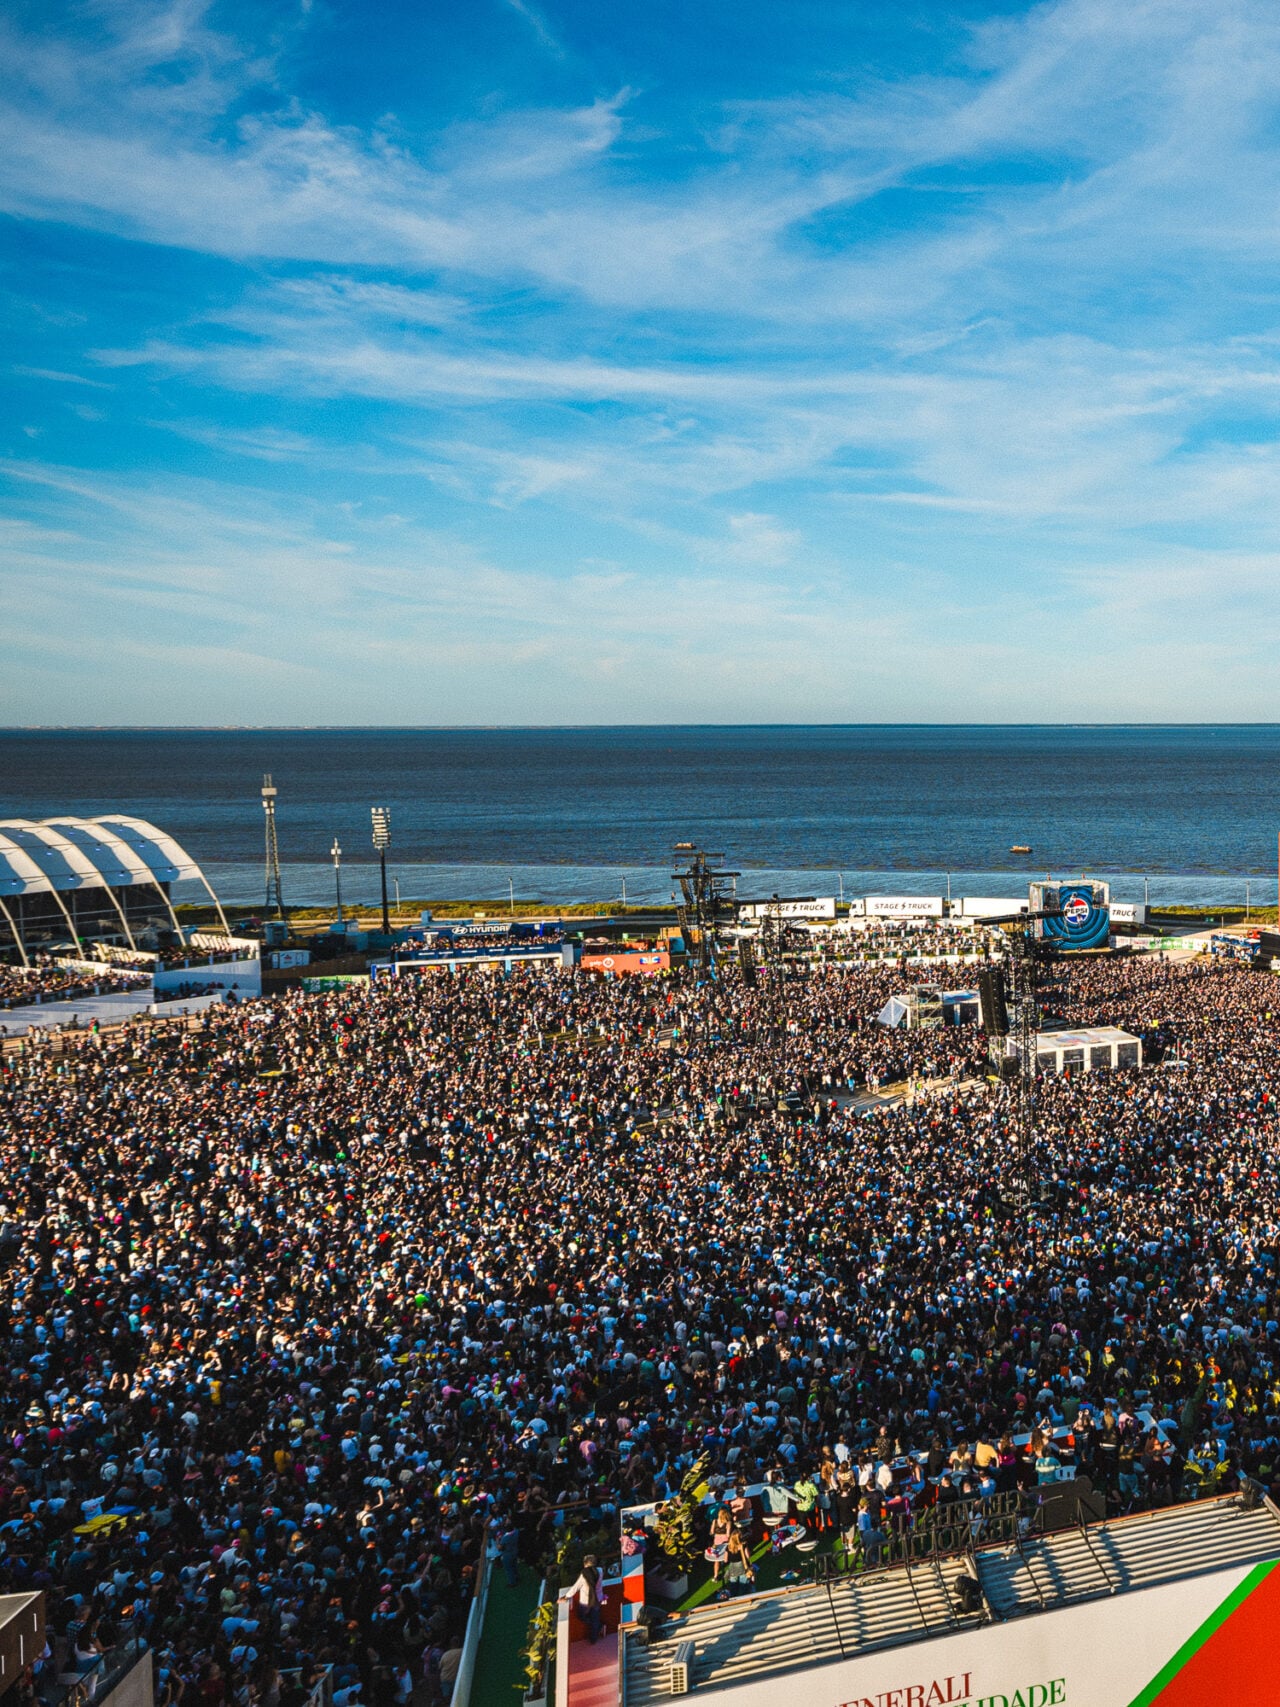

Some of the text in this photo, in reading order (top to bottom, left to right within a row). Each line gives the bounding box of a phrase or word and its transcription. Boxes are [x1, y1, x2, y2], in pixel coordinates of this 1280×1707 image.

[763, 904, 790, 912] STAGE
[1112, 909, 1137, 917] TRUCK
[469, 925, 509, 934] HYUNDAI
[835, 1672, 972, 1707] ERALI
